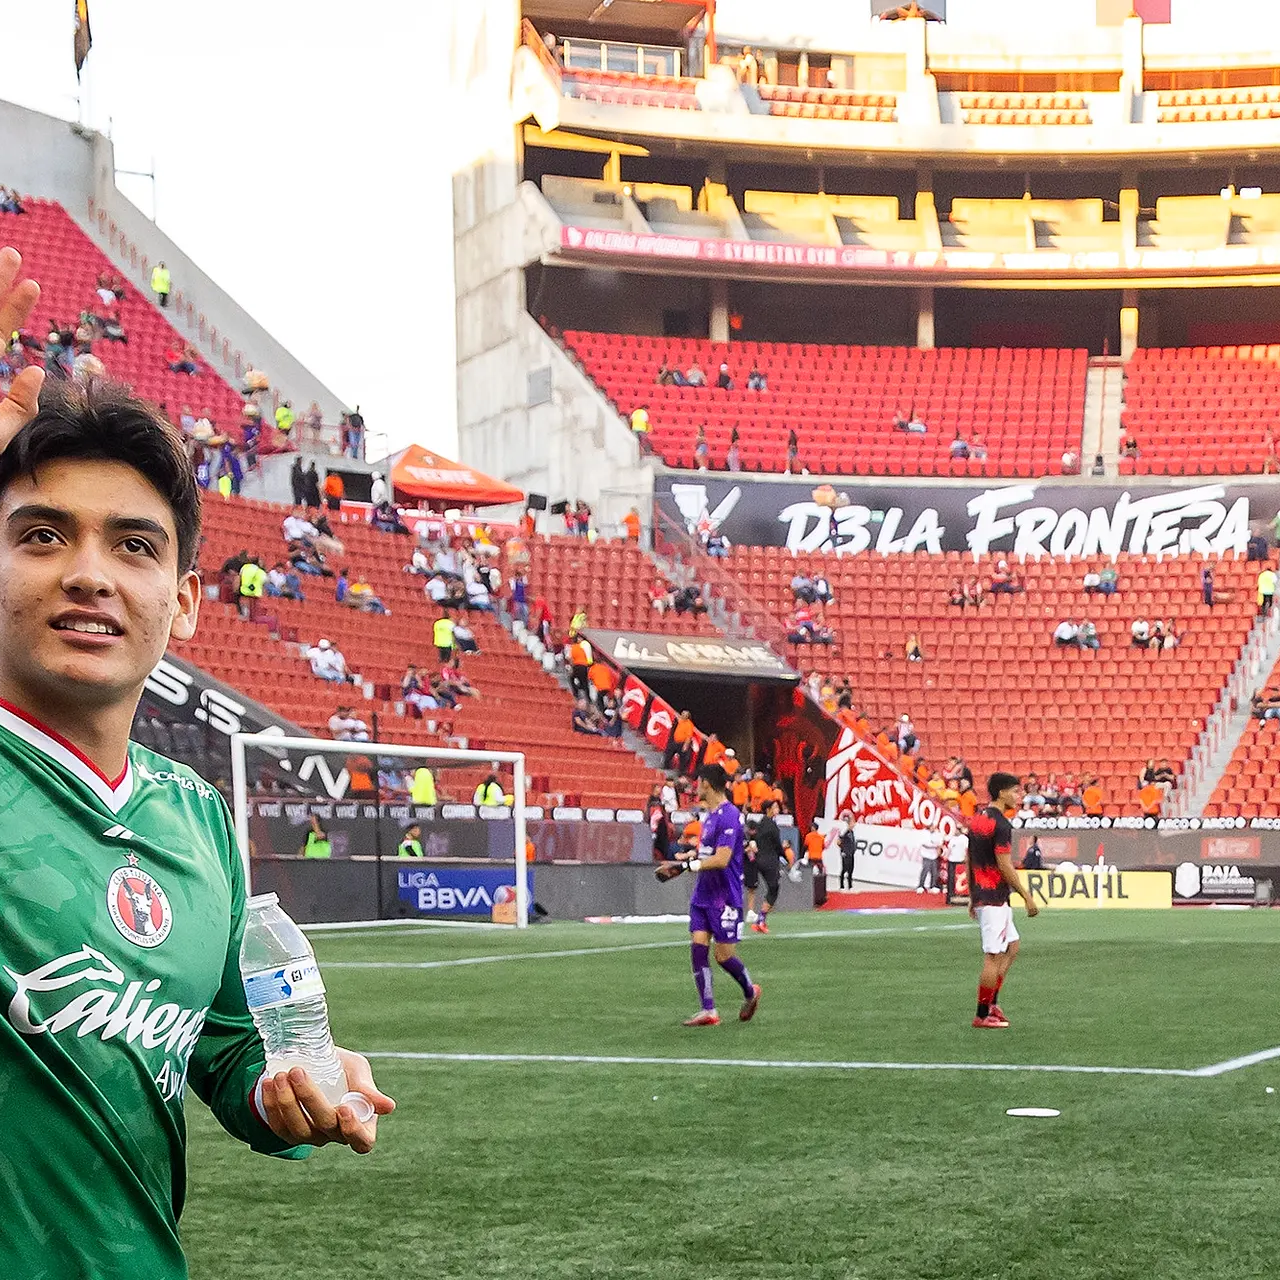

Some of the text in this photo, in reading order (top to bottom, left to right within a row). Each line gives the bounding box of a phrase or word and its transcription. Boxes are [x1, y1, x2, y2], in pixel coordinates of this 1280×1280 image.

[966, 483, 1251, 563] FRONTERA
[398, 872, 440, 888] LIGA
[1027, 872, 1129, 905] RDAHL
[418, 886, 493, 910] BBVA
